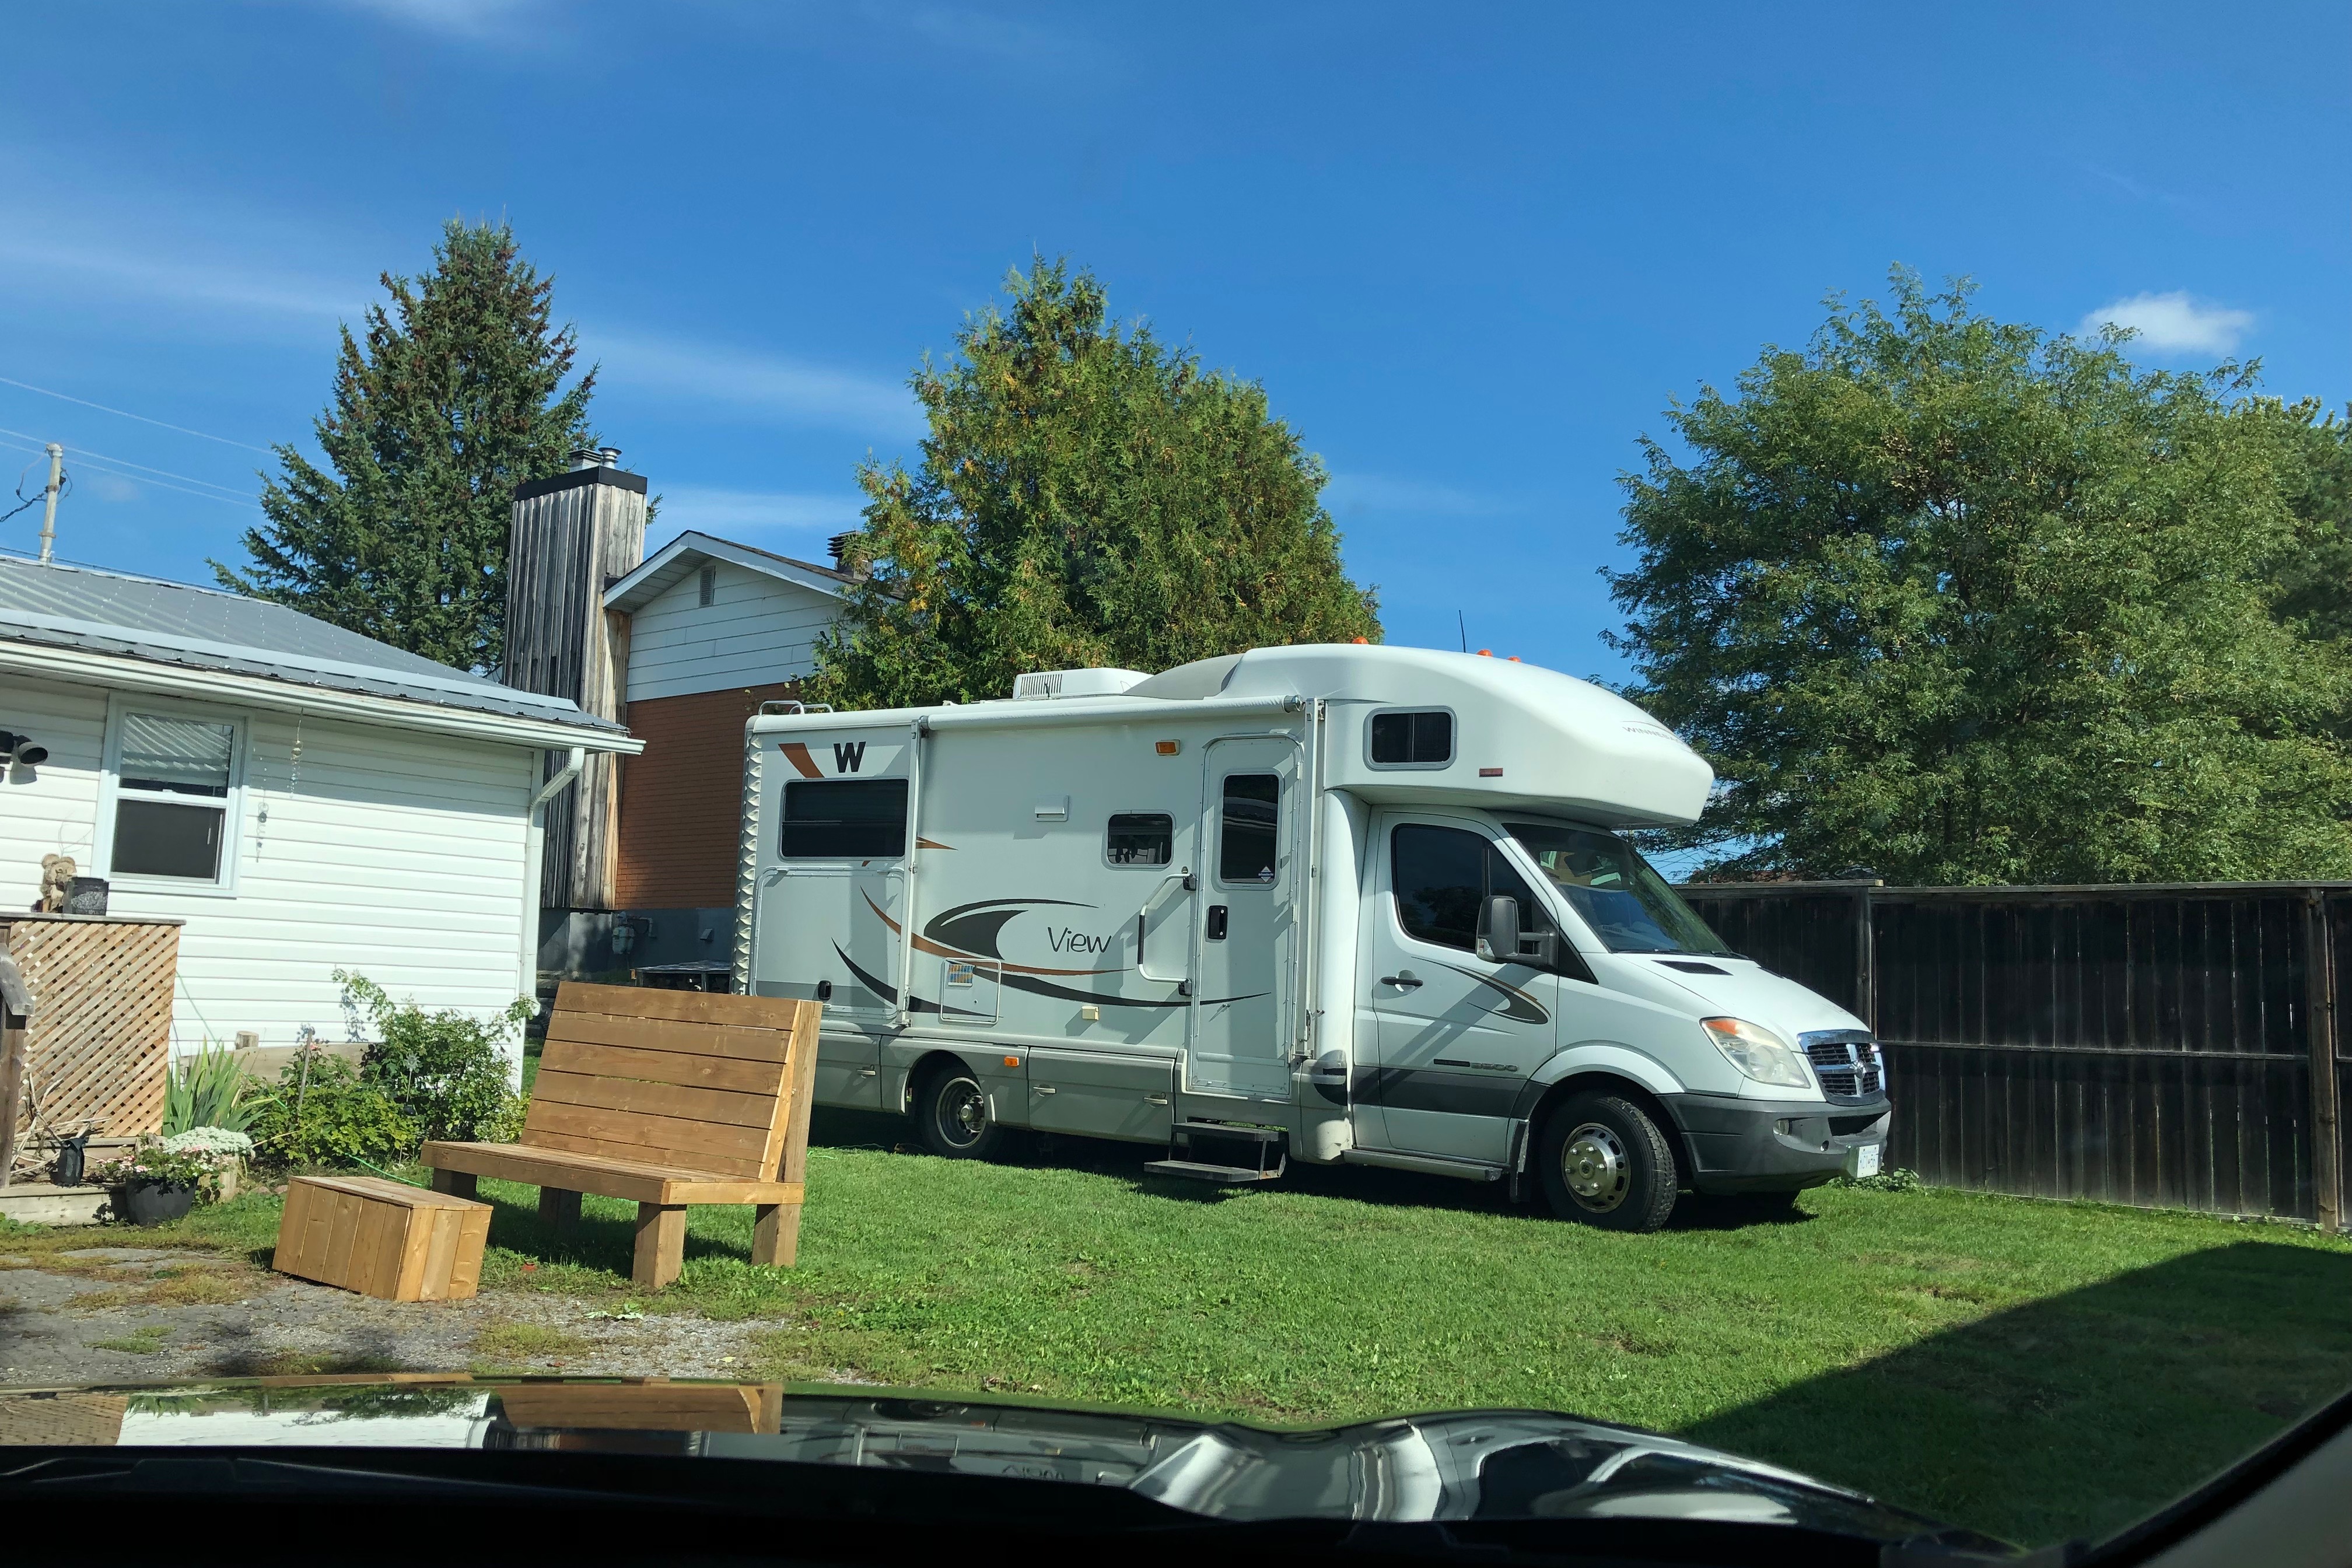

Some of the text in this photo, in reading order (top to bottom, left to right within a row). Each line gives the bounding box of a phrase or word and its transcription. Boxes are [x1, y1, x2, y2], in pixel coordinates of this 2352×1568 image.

[1622, 726, 1684, 745] WINNEBA
[833, 741, 866, 774] W
[1047, 926, 1112, 953] View
